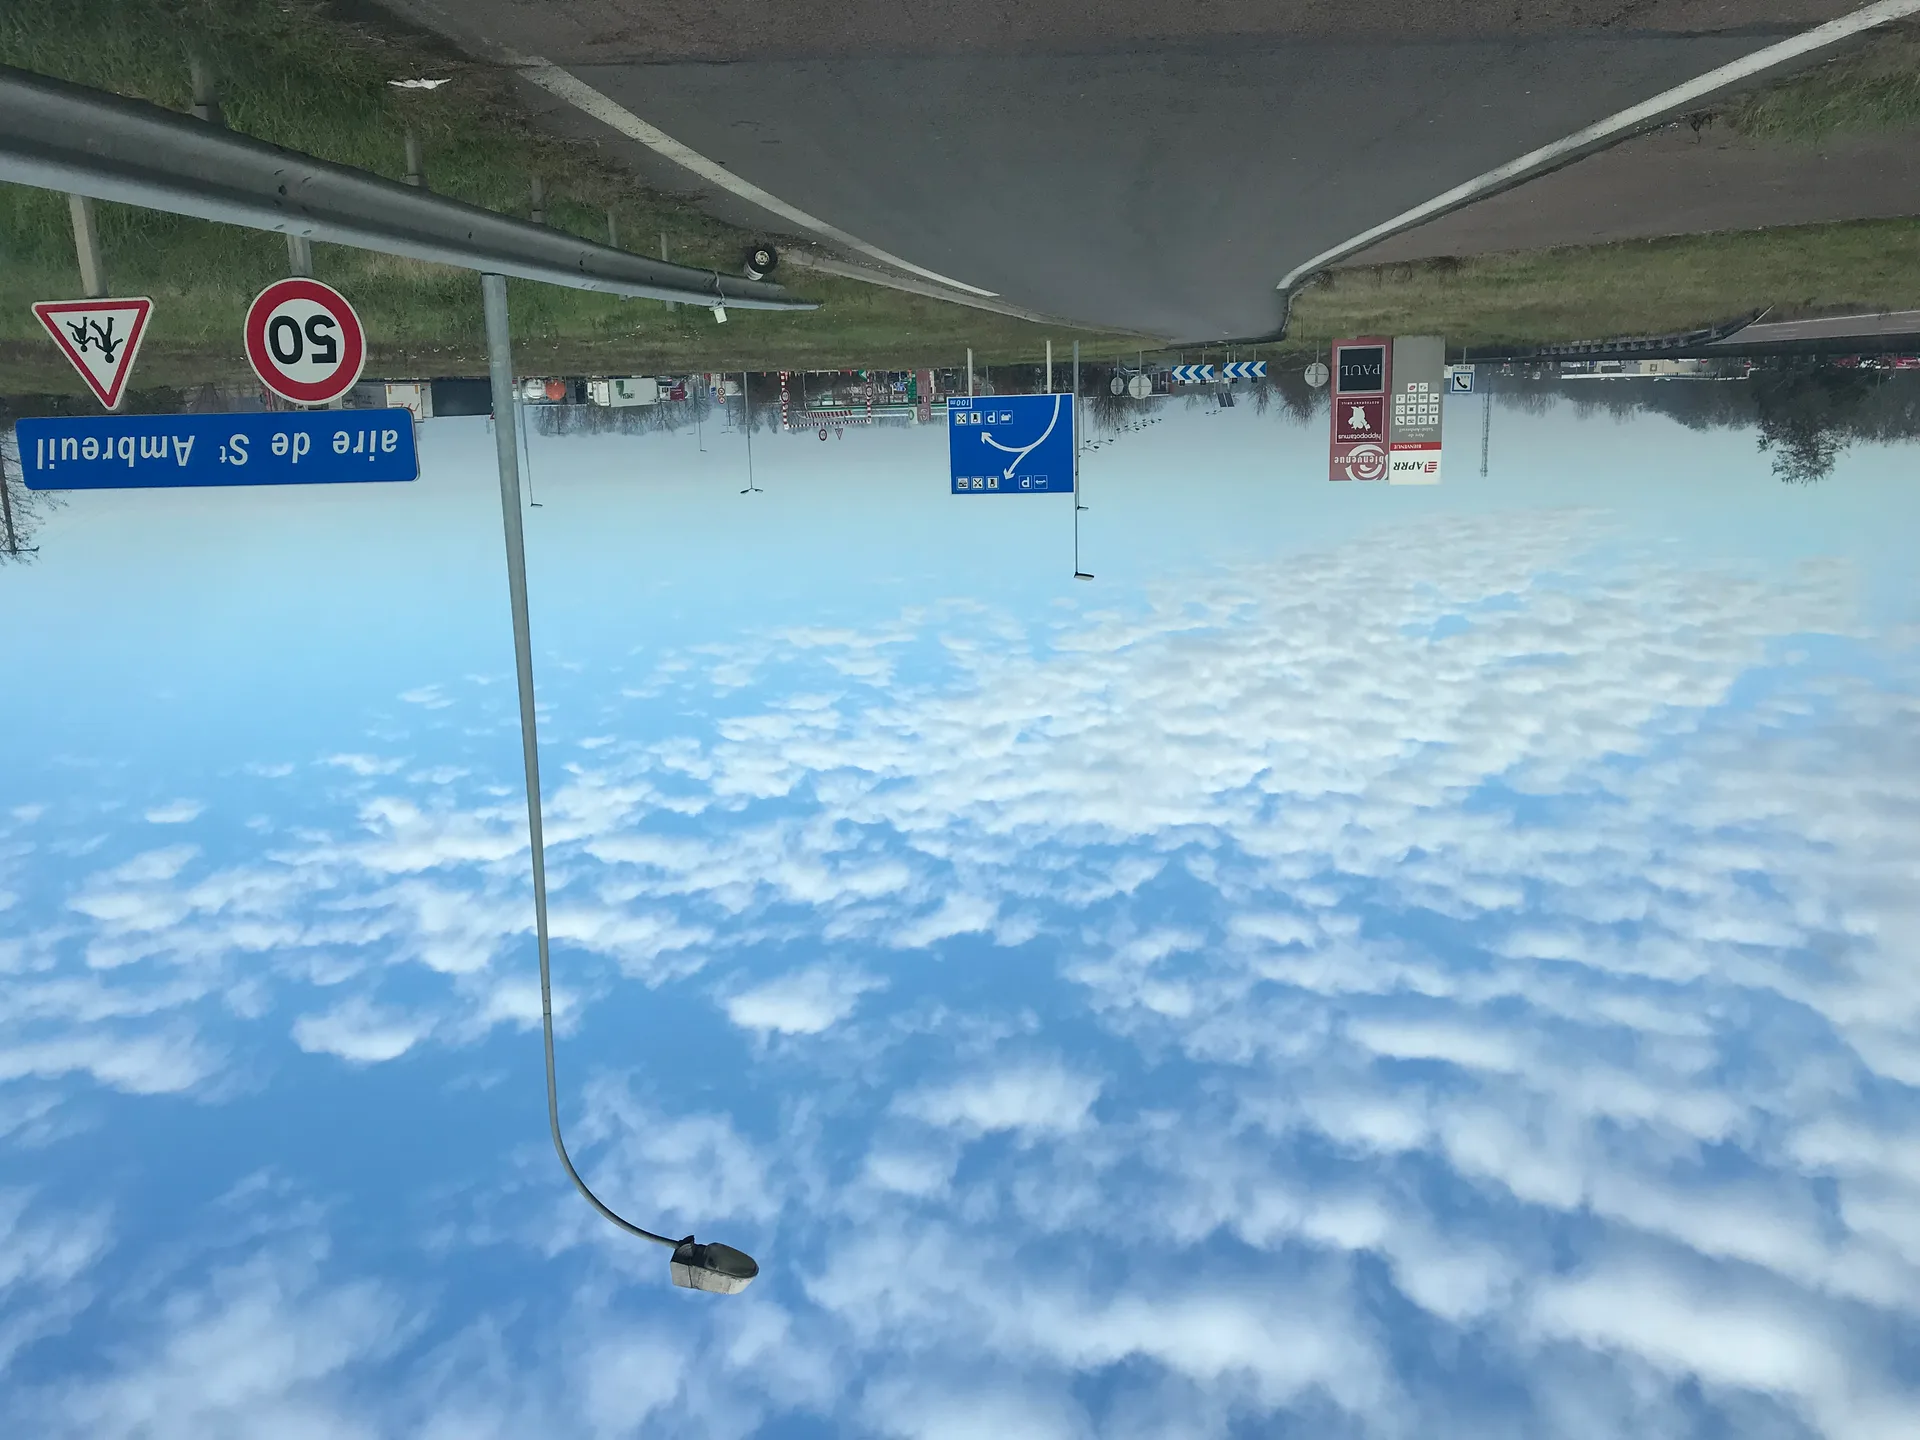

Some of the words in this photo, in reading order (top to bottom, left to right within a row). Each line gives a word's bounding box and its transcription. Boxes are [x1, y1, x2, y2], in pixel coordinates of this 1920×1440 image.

[269, 315, 337, 365] 50
[1341, 364, 1380, 376] PAUL
[988, 412, 995, 422] P
[1338, 432, 1381, 440] hippopotamus
[219, 433, 250, 466] St
[271, 432, 310, 464] de
[332, 429, 398, 461] aire
[37, 435, 195, 469] Ambreuil
[1334, 456, 1384, 464] bienvenue
[1393, 462, 1424, 470] APRR
[1022, 477, 1029, 487] P
